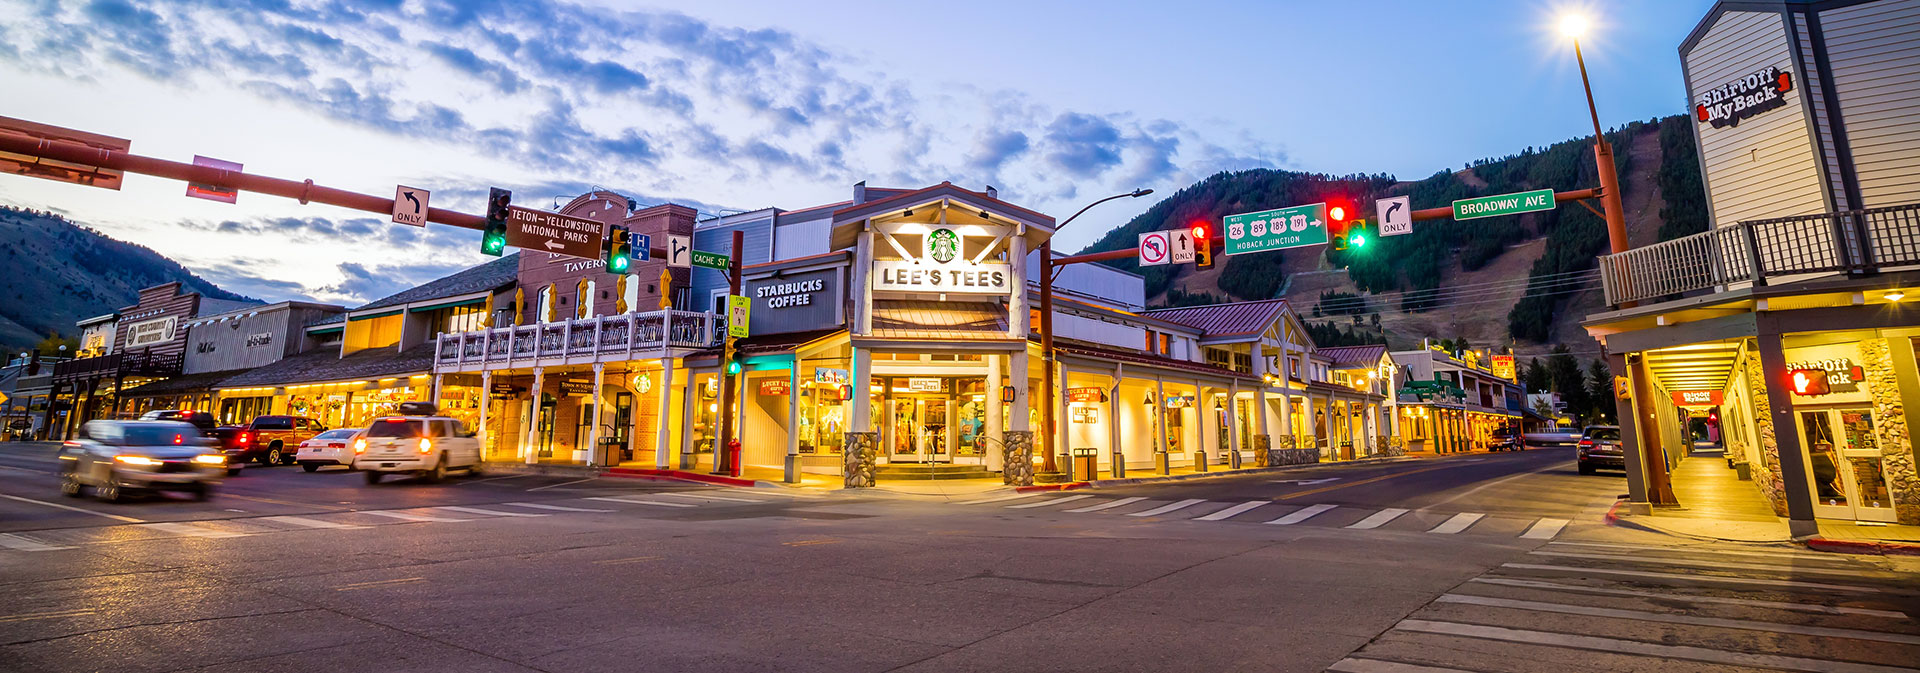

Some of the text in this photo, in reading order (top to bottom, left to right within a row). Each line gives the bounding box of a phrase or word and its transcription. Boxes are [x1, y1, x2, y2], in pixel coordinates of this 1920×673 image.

[1702, 66, 1774, 107] ShirtOff
[1706, 86, 1777, 122] MyBack
[1460, 194, 1546, 215] BROADWAY AVE
[398, 213, 421, 223] ONLY
[521, 223, 560, 239] NATIONAL
[564, 231, 588, 244] PARKS
[1232, 218, 1304, 236] 26 89 189 191
[1384, 223, 1406, 232] ONLY
[637, 235, 644, 247] H
[1237, 236, 1300, 249] HOBACK JUNCTION
[694, 254, 726, 266] CACHE ST
[1175, 252, 1194, 261] ONLY
[883, 268, 1004, 287] LEE'S TEES
[757, 279, 823, 298] STARBUCKS
[768, 294, 810, 309] COFFEE
